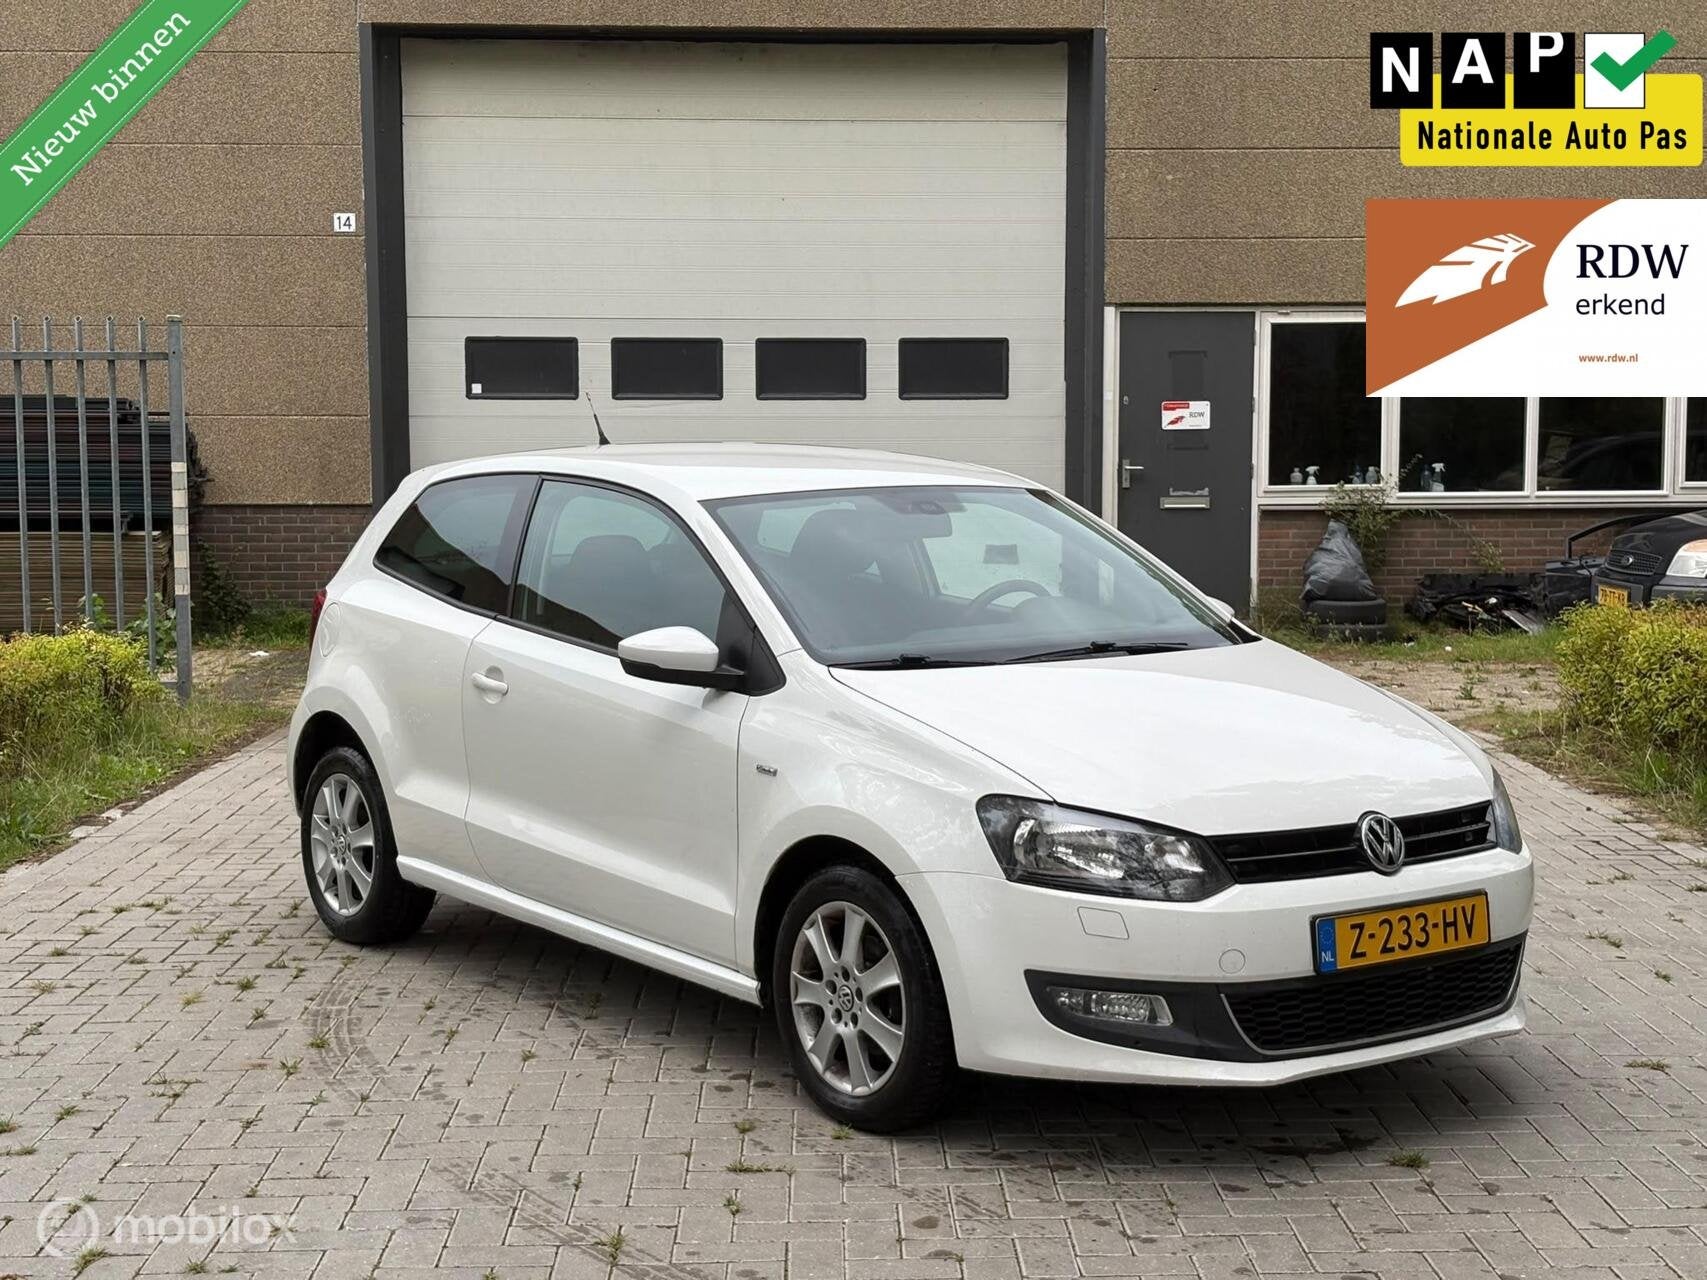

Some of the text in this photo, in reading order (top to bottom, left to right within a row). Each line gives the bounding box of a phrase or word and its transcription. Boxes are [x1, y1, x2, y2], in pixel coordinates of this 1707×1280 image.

[336, 215, 352, 230] 14
[1350, 904, 1476, 959] Z-233-HV
[1321, 951, 1335, 962] NL
